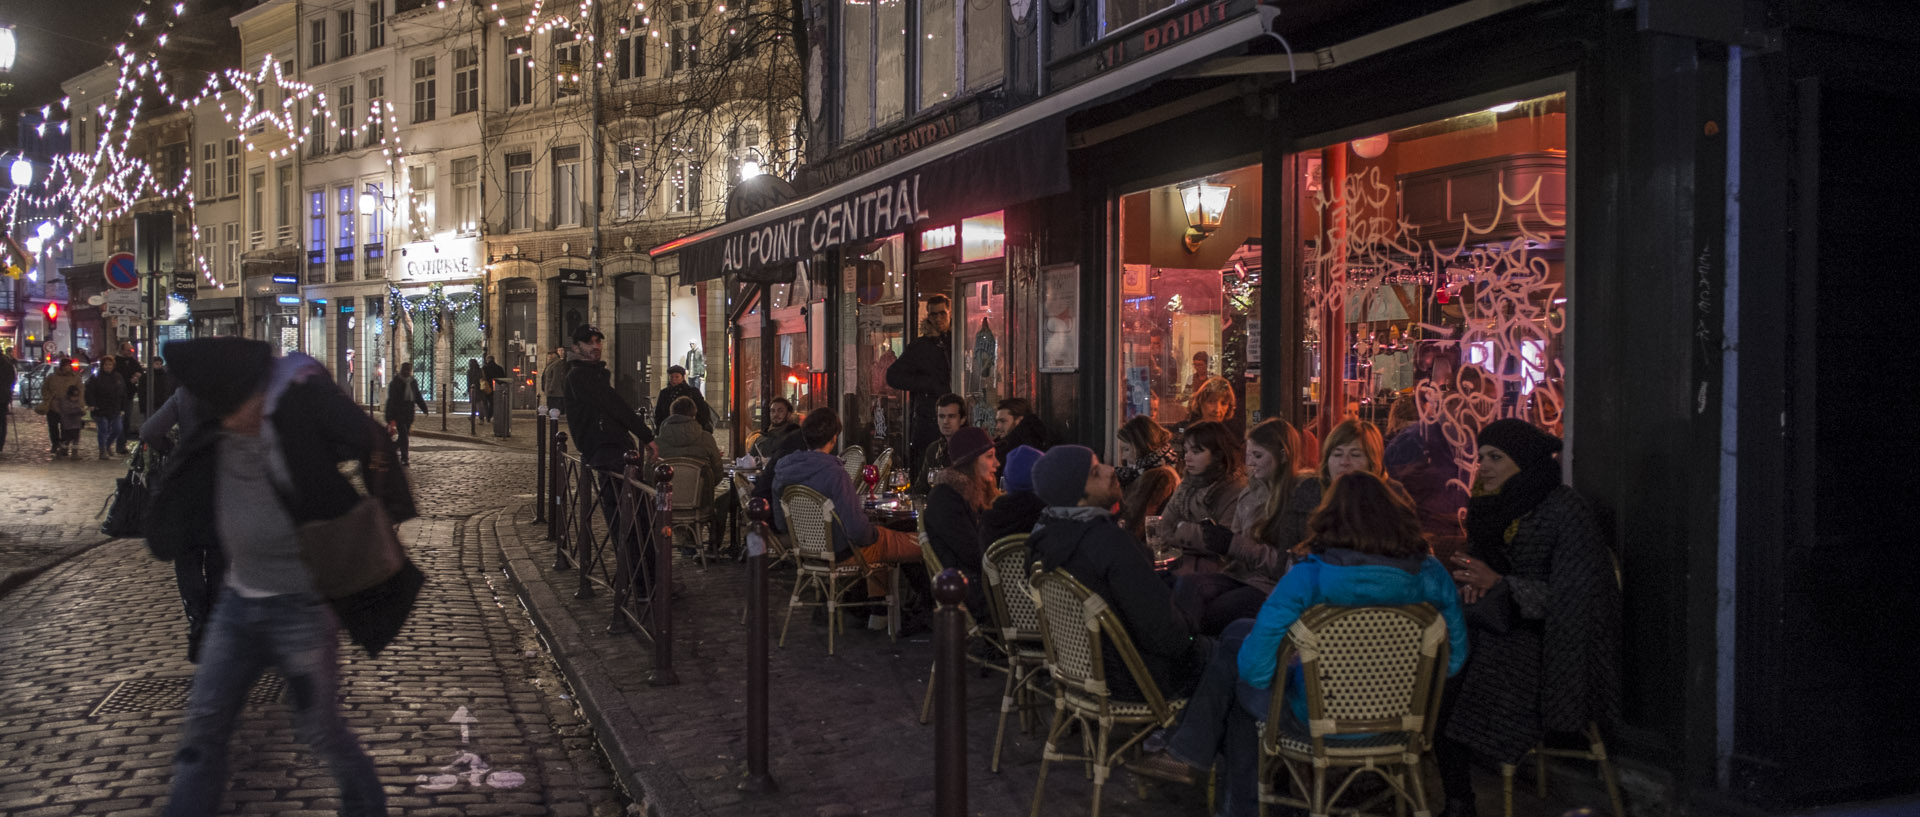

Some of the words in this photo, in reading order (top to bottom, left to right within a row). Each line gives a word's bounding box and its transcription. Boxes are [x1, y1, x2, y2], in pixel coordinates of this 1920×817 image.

[1143, 2, 1227, 52] POINT
[721, 233, 744, 271] AU
[747, 217, 805, 267] POINT
[810, 173, 929, 253] CENTRAL
